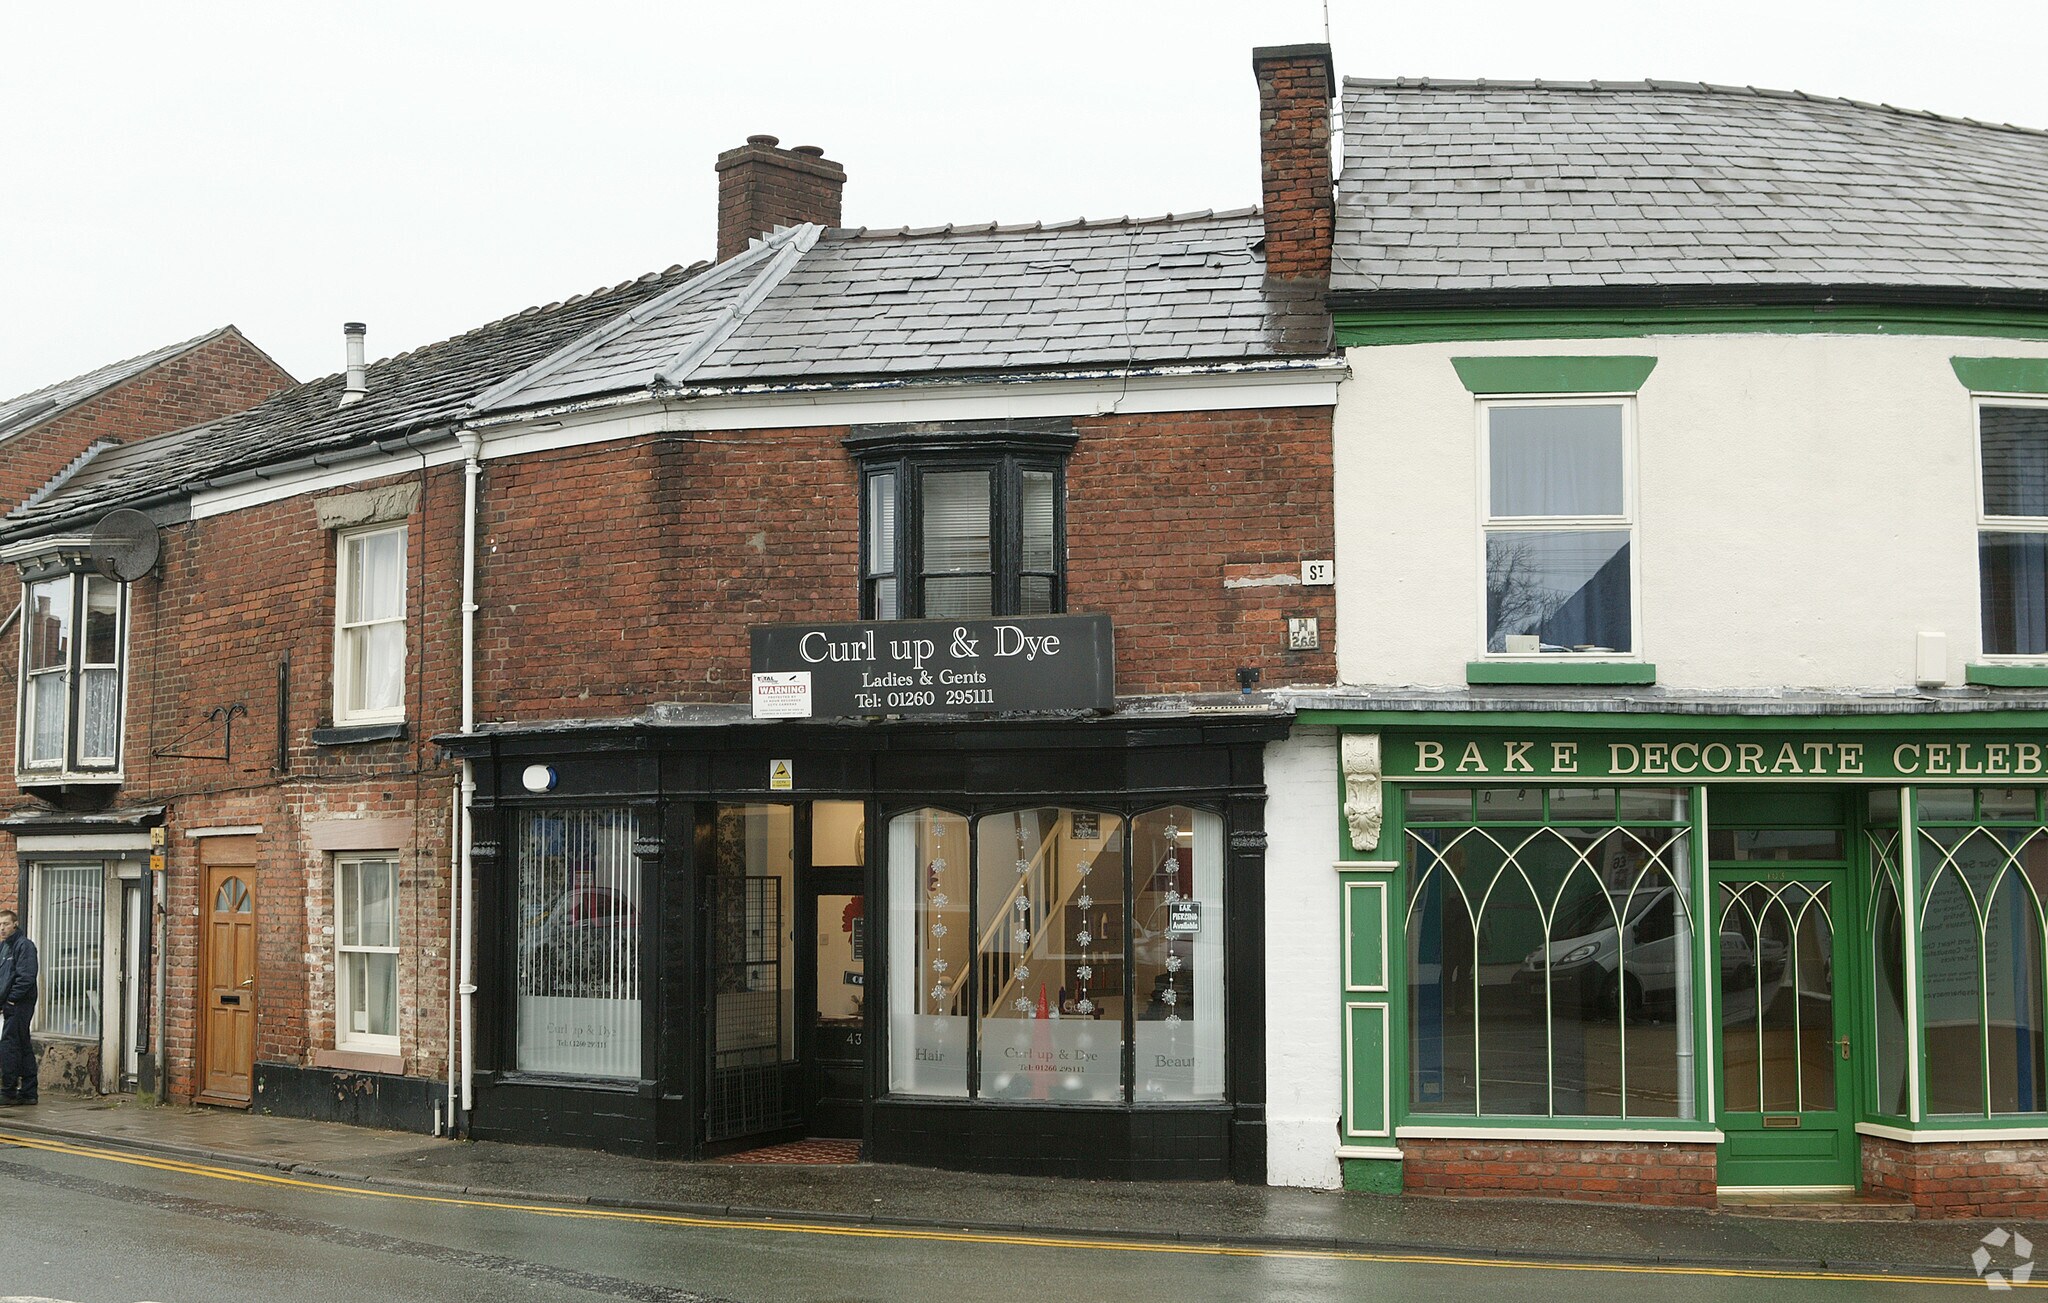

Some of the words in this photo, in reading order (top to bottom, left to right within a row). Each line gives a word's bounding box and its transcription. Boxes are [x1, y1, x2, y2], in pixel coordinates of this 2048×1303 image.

[1309, 565, 1324, 580] ST
[799, 630, 877, 664] Curl
[890, 638, 935, 670] up
[949, 626, 980, 659] &
[993, 625, 1061, 661] Dye
[862, 672, 913, 688] Ladies
[919, 670, 934, 686] &
[939, 669, 987, 685] Gents
[759, 685, 806, 694] WARNING
[855, 694, 882, 708] Tel:
[887, 691, 936, 707] 01260
[945, 689, 994, 705] 295111
[1414, 741, 1578, 772] BAKE
[1608, 742, 1864, 774] DECORATE
[1893, 743, 2048, 774] CELEB
[1179, 904, 1192, 912] EAR
[1172, 912, 1198, 921] PIERCING
[1172, 921, 1199, 930] Available
[846, 1032, 863, 1045] 43
[915, 1047, 945, 1062] Hair
[1004, 1047, 1033, 1059] Curl
[1038, 1050, 1053, 1062] up
[1058, 1049, 1069, 1060] &
[1074, 1049, 1098, 1062] Dye
